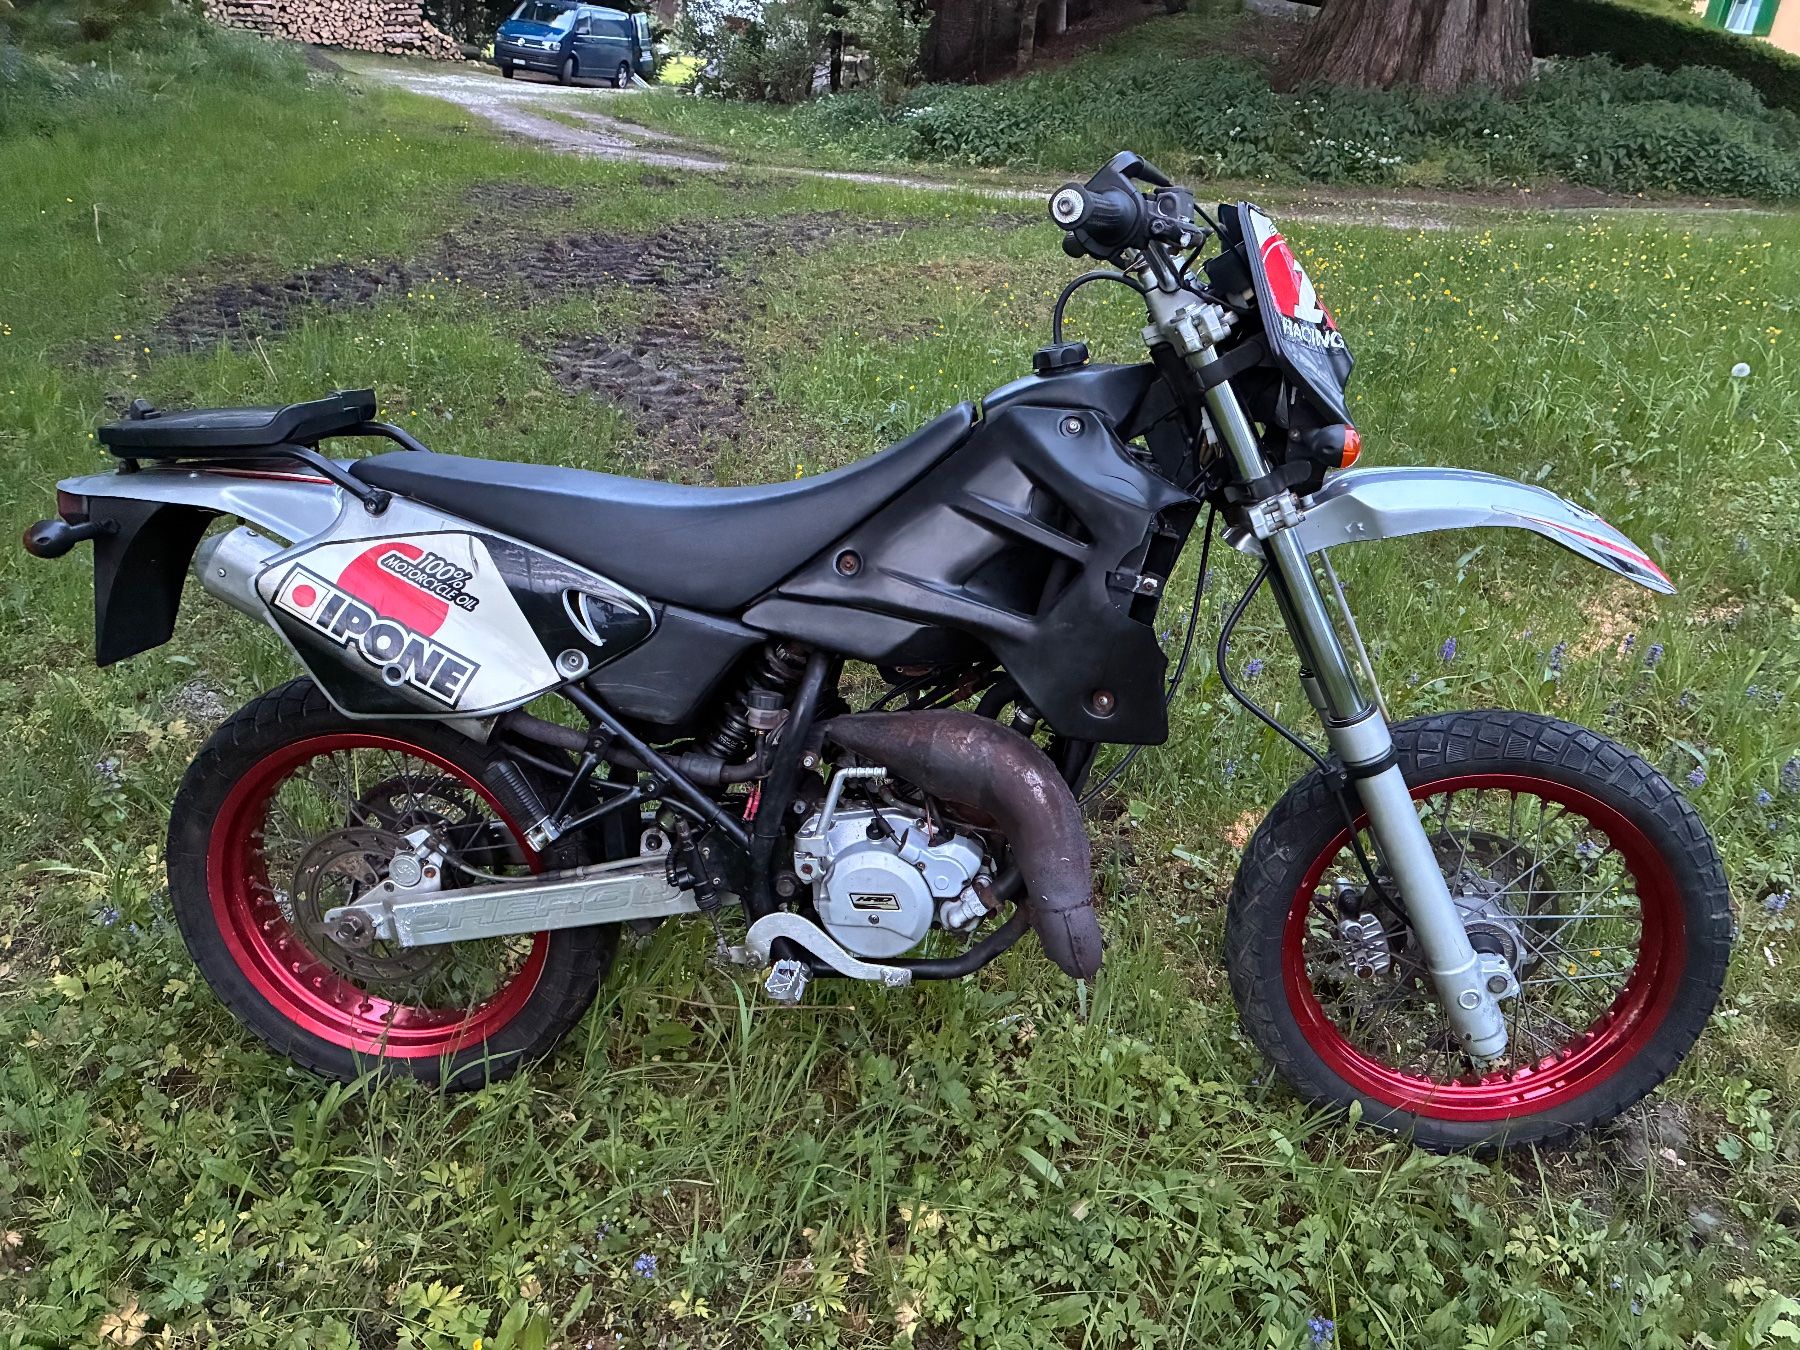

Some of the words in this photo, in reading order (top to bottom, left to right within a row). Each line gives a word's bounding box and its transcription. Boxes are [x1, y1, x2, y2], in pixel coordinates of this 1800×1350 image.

[1282, 317, 1345, 349] RACING
[384, 556, 459, 599] MOTORCYCLE
[455, 594, 477, 610] OIL
[418, 555, 470, 588] 100%
[316, 593, 470, 700] IPONE
